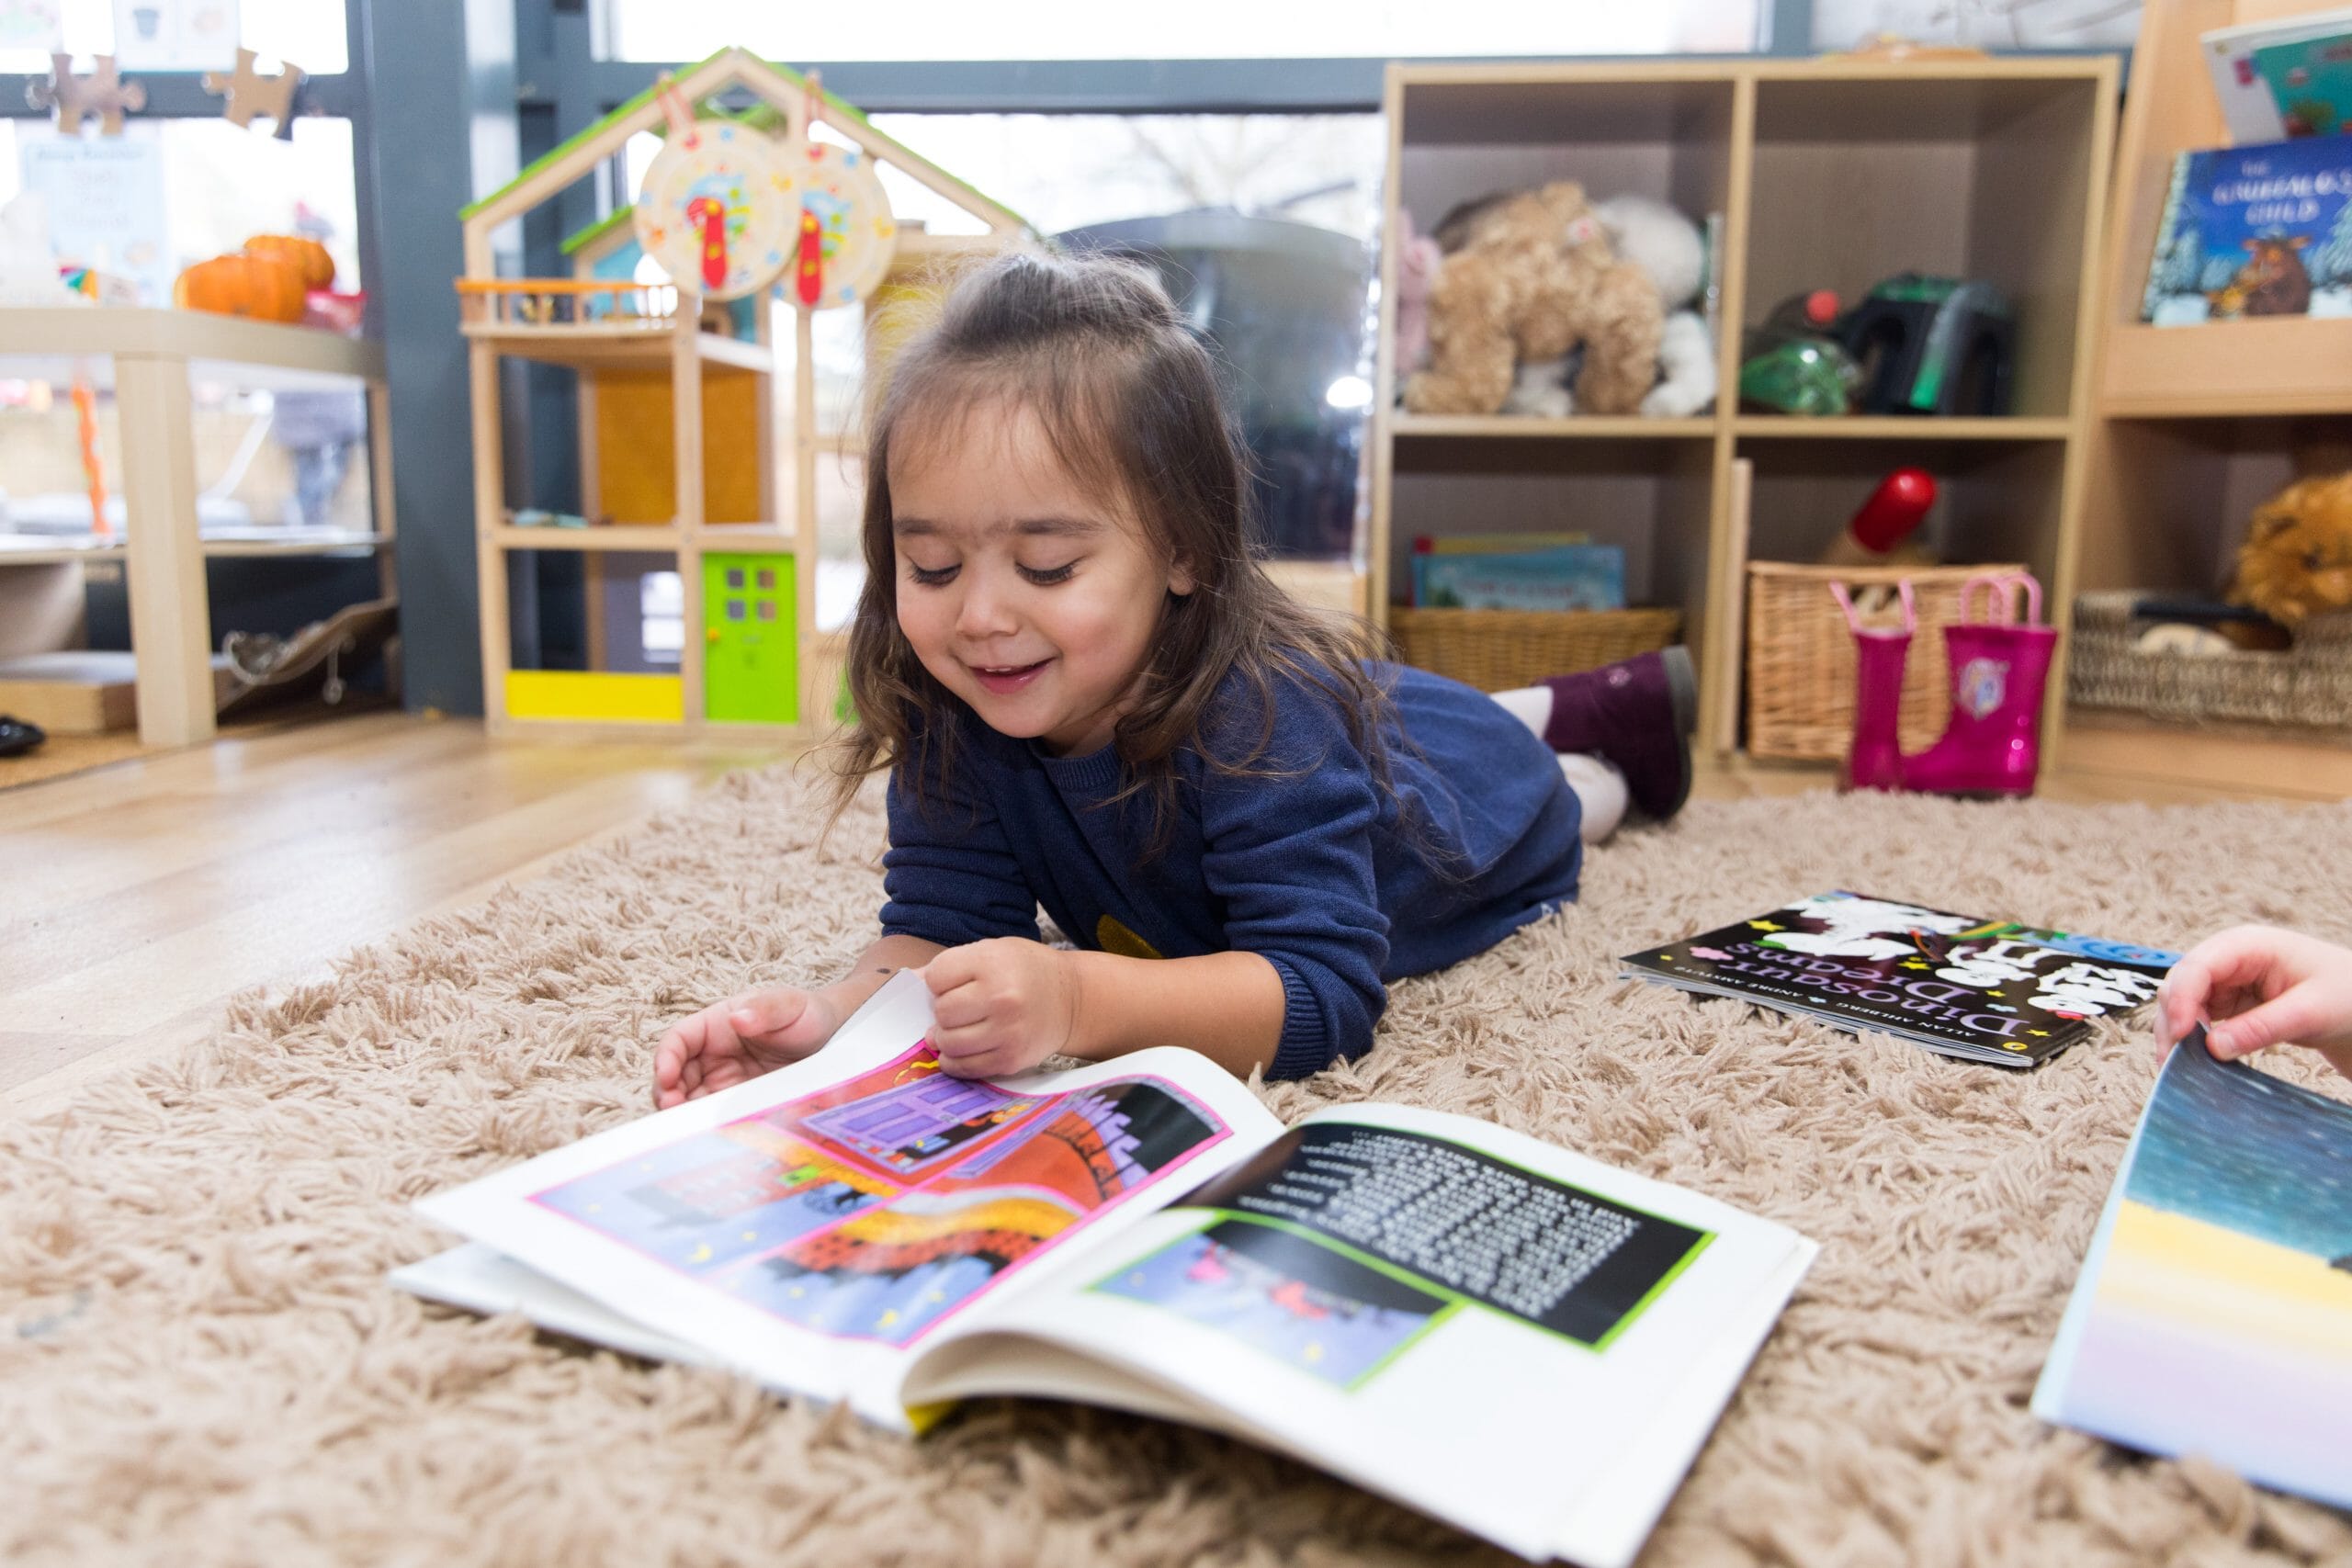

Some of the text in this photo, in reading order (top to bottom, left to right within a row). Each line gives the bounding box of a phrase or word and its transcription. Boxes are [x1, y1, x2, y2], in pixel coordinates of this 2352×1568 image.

[1718, 960, 2031, 1037] Dinosaur
[1724, 942, 1977, 1004] Dreams
[1836, 1001, 1976, 1037] ALLAN AHLBERG
